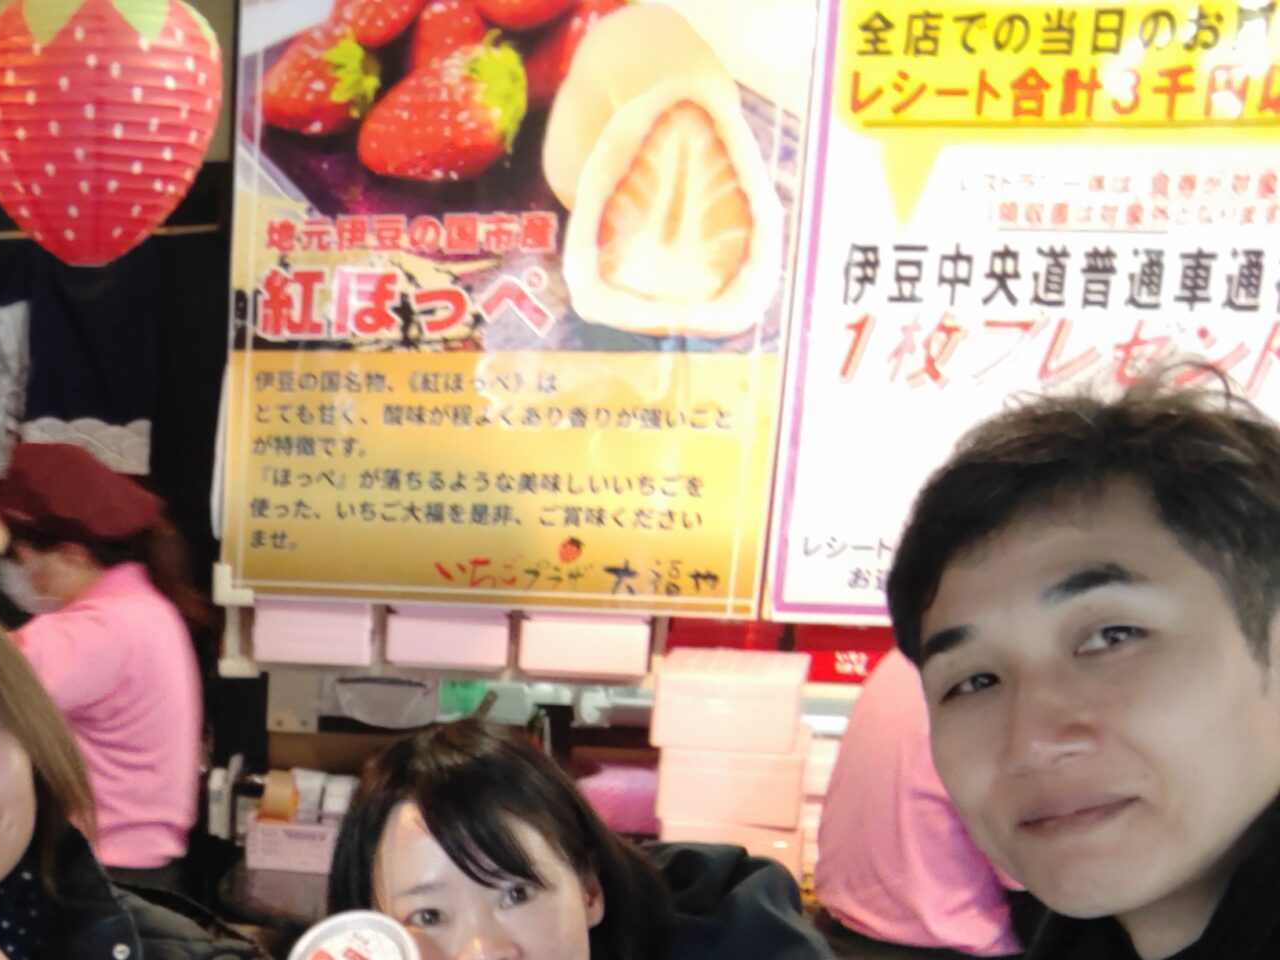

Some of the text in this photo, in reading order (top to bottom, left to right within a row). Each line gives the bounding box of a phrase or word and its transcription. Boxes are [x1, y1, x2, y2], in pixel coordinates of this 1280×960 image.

[266, 212, 557, 252] 地元伊豆の国市産
[260, 265, 555, 338] 紅ほっぺ
[843, 242, 1280, 312] 伊豆中央道普通車通
